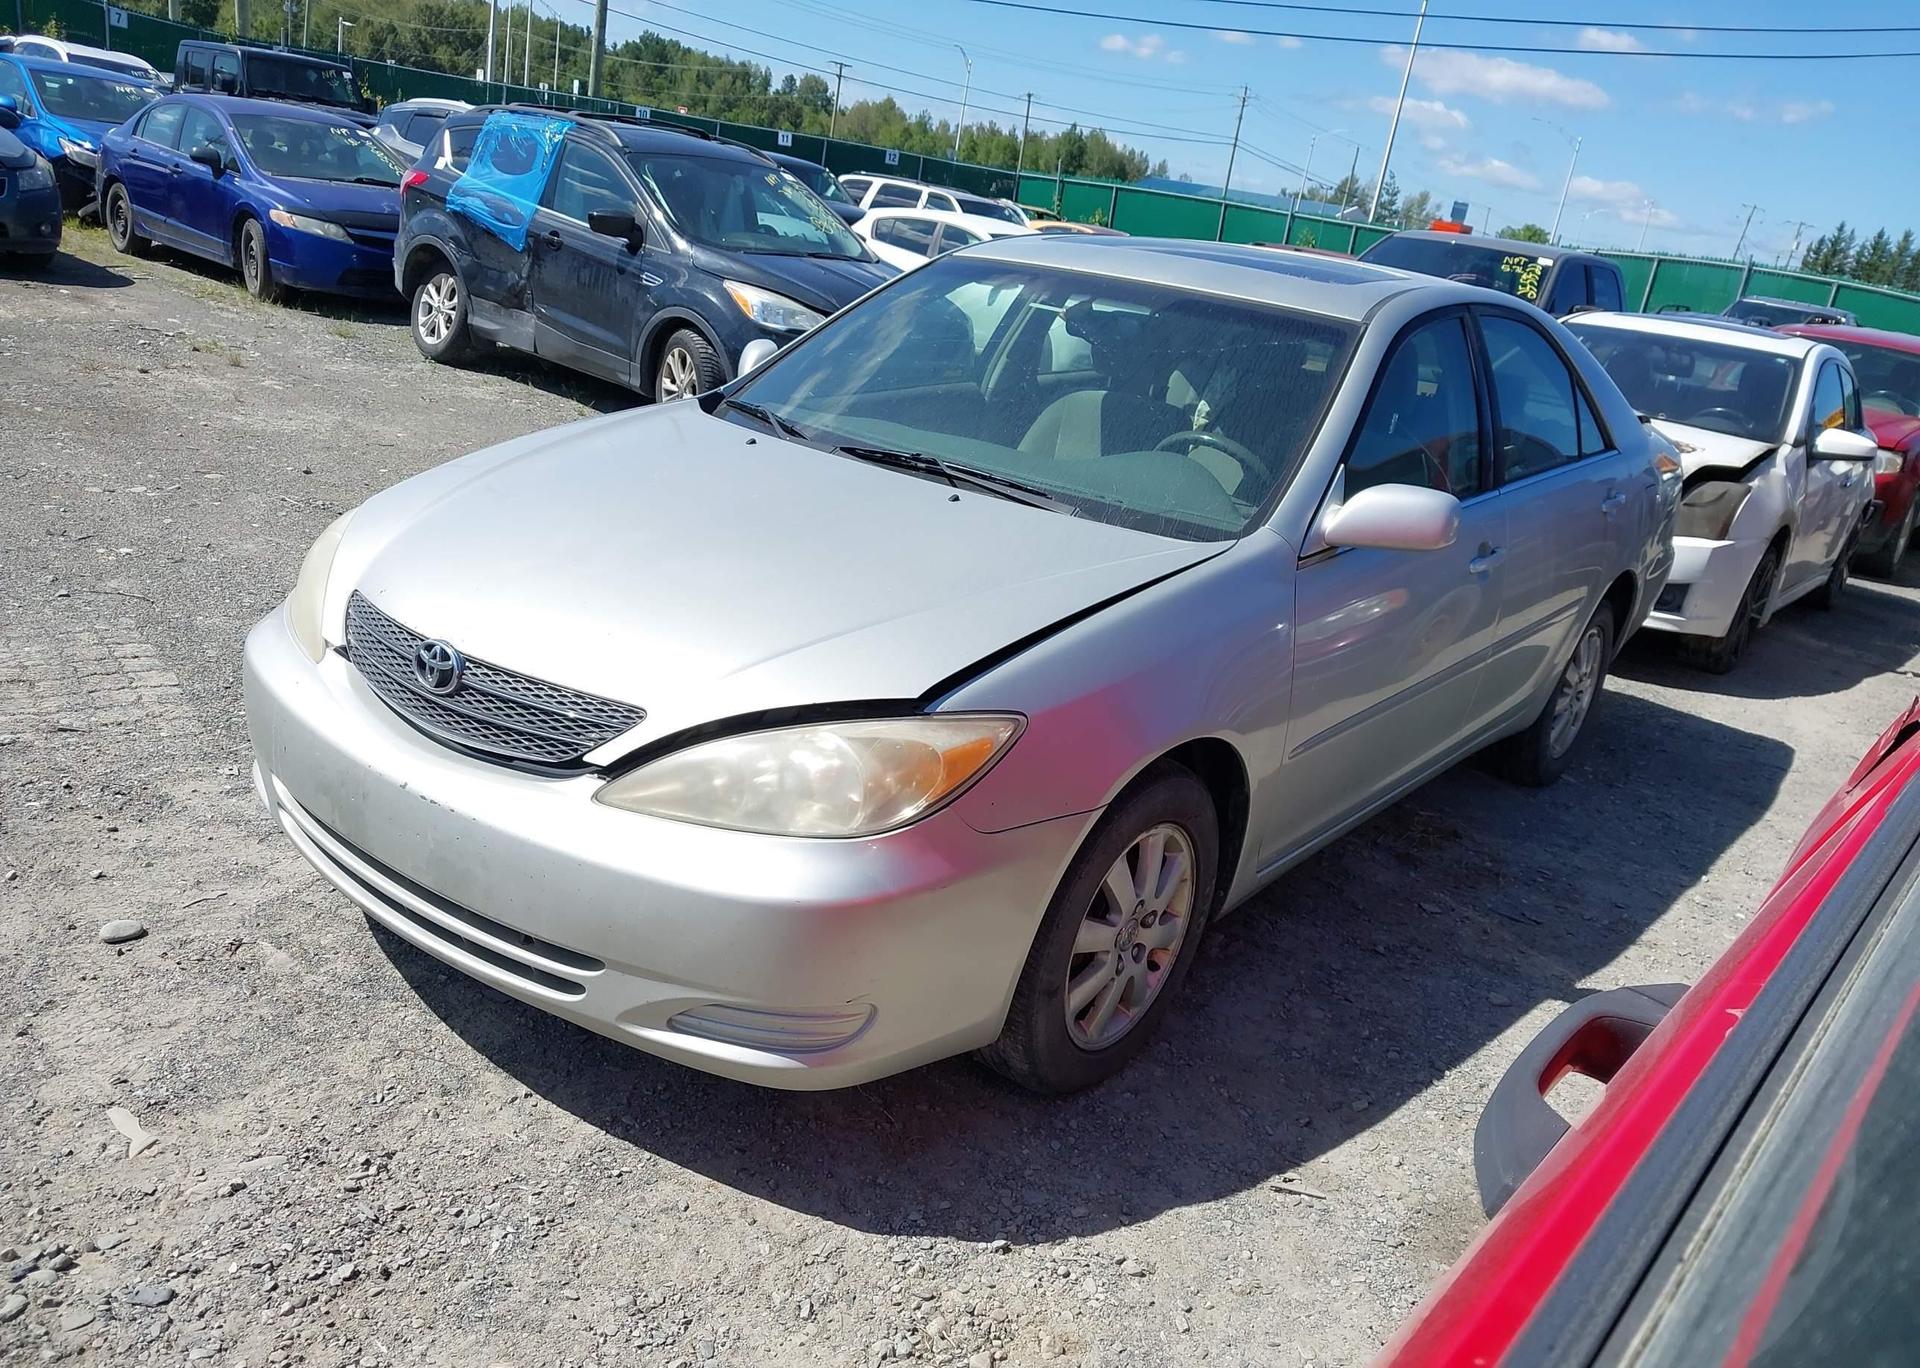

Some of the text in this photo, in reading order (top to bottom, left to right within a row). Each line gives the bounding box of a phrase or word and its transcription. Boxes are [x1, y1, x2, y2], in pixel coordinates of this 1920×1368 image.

[115, 11, 122, 24] 7
[115, 85, 137, 95] NPT
[781, 133, 789, 143] 11
[888, 152, 897, 163] 12
[1503, 256, 1528, 265] NPT
